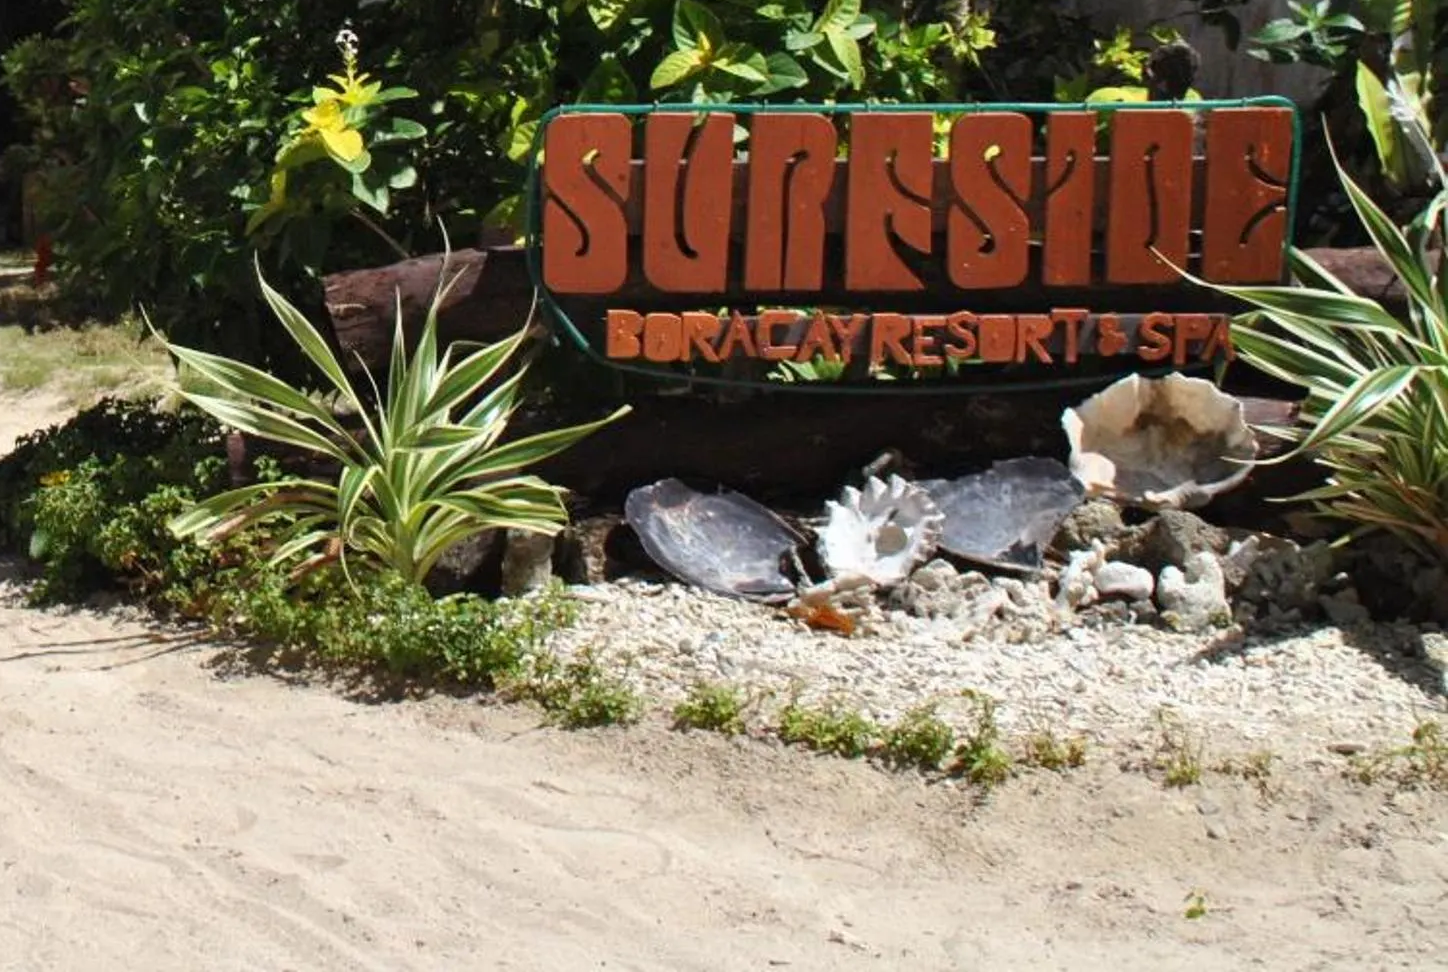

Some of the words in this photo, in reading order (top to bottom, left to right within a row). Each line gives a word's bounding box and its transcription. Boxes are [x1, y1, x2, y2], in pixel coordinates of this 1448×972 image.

[542, 106, 1294, 294] SURFSIDE
[606, 308, 870, 365] BORACAY
[870, 308, 1089, 367] RESORT
[1097, 312, 1129, 358] &
[1135, 311, 1236, 366] SPA
